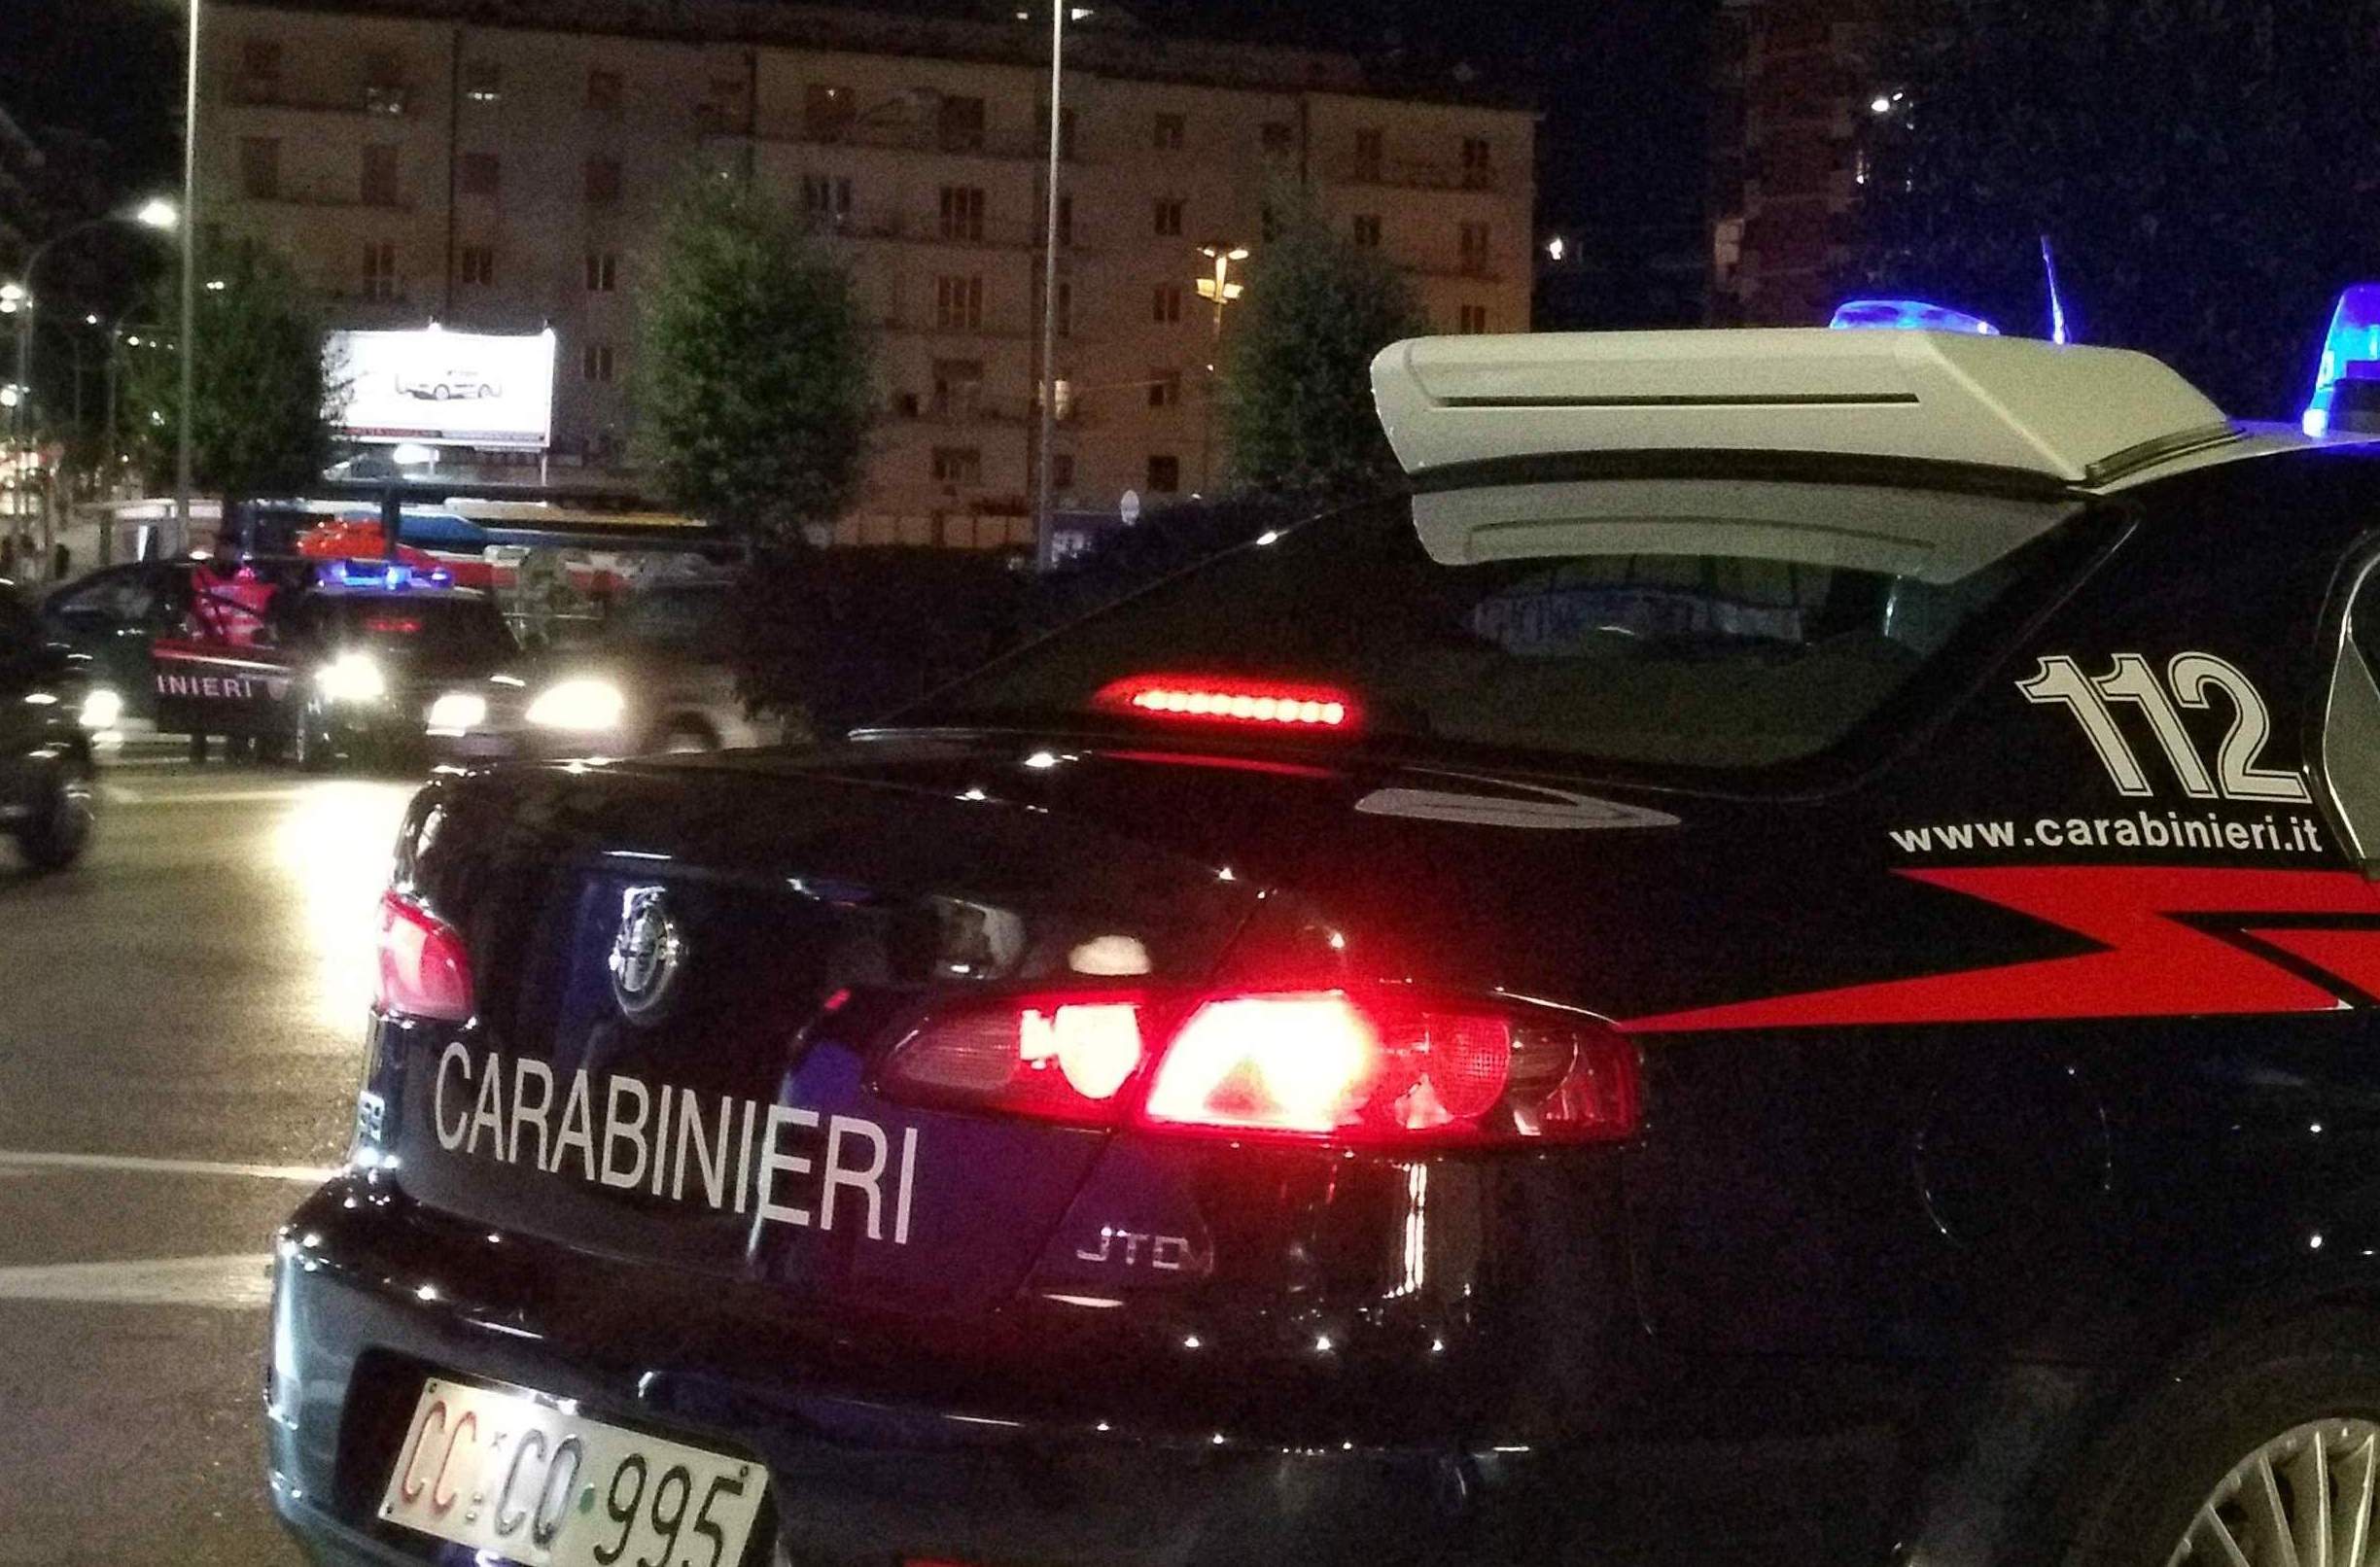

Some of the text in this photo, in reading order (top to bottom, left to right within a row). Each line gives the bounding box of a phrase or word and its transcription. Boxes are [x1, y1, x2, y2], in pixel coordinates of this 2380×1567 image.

[157, 674, 253, 699] INIERI
[2014, 651, 2313, 805] 112
[1889, 811, 2323, 853] www.carabinieri.it
[436, 1042, 918, 1244] CARABINIERI
